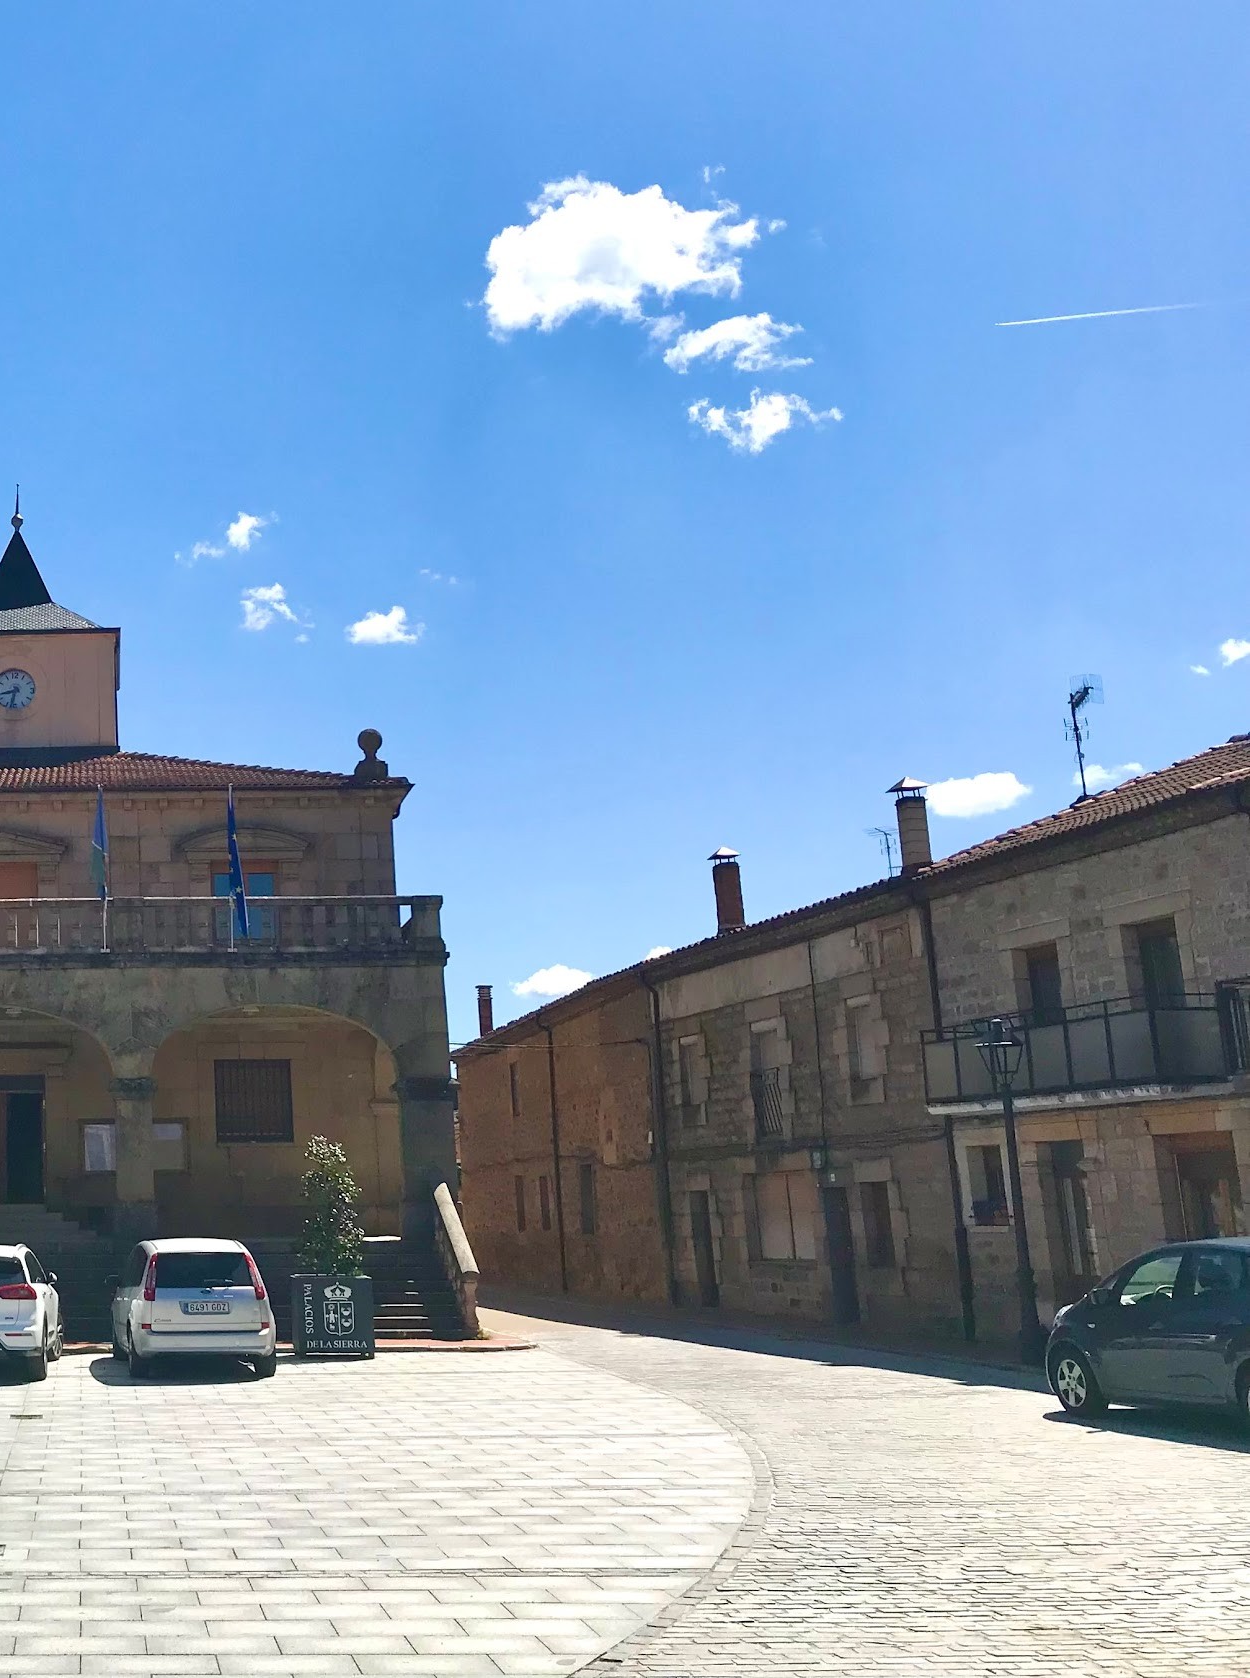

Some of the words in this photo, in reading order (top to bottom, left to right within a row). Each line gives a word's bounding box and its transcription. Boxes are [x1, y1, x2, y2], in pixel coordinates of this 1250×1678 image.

[11, 672, 19, 680] 12
[190, 1303, 208, 1311] 6491
[211, 1303, 226, 1311] GDZ
[303, 1283, 315, 1334] PALACIOS
[306, 1340, 319, 1349] DE
[320, 1340, 332, 1349] LA
[333, 1340, 368, 1349] SIERRA
